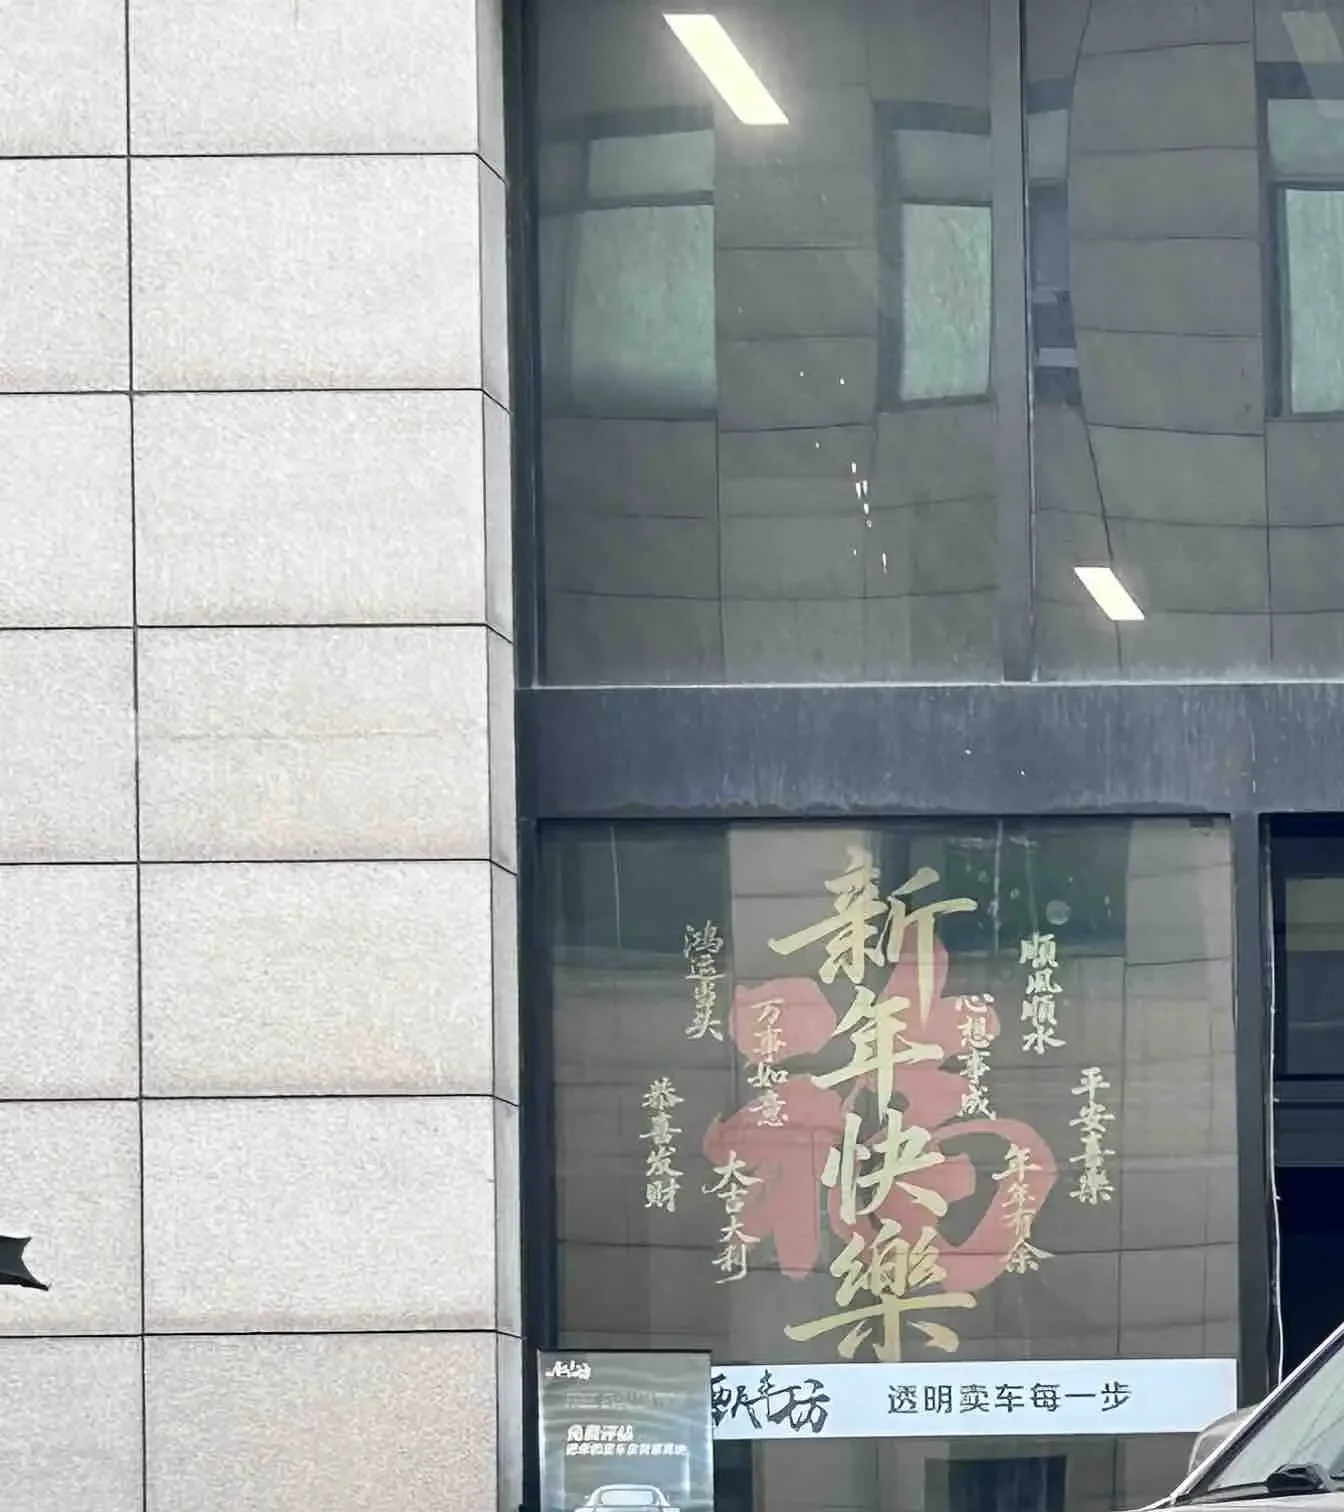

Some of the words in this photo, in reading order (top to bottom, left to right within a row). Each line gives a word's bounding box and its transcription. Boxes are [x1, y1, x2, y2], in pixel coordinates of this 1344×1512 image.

[747, 998, 790, 1127] 万事如意
[954, 992, 996, 1121] 心想事成
[702, 1150, 763, 1285] 大吉大利
[992, 1143, 1056, 1274] 年年有余
[888, 1381, 1132, 1414] 透明卖车每一步
